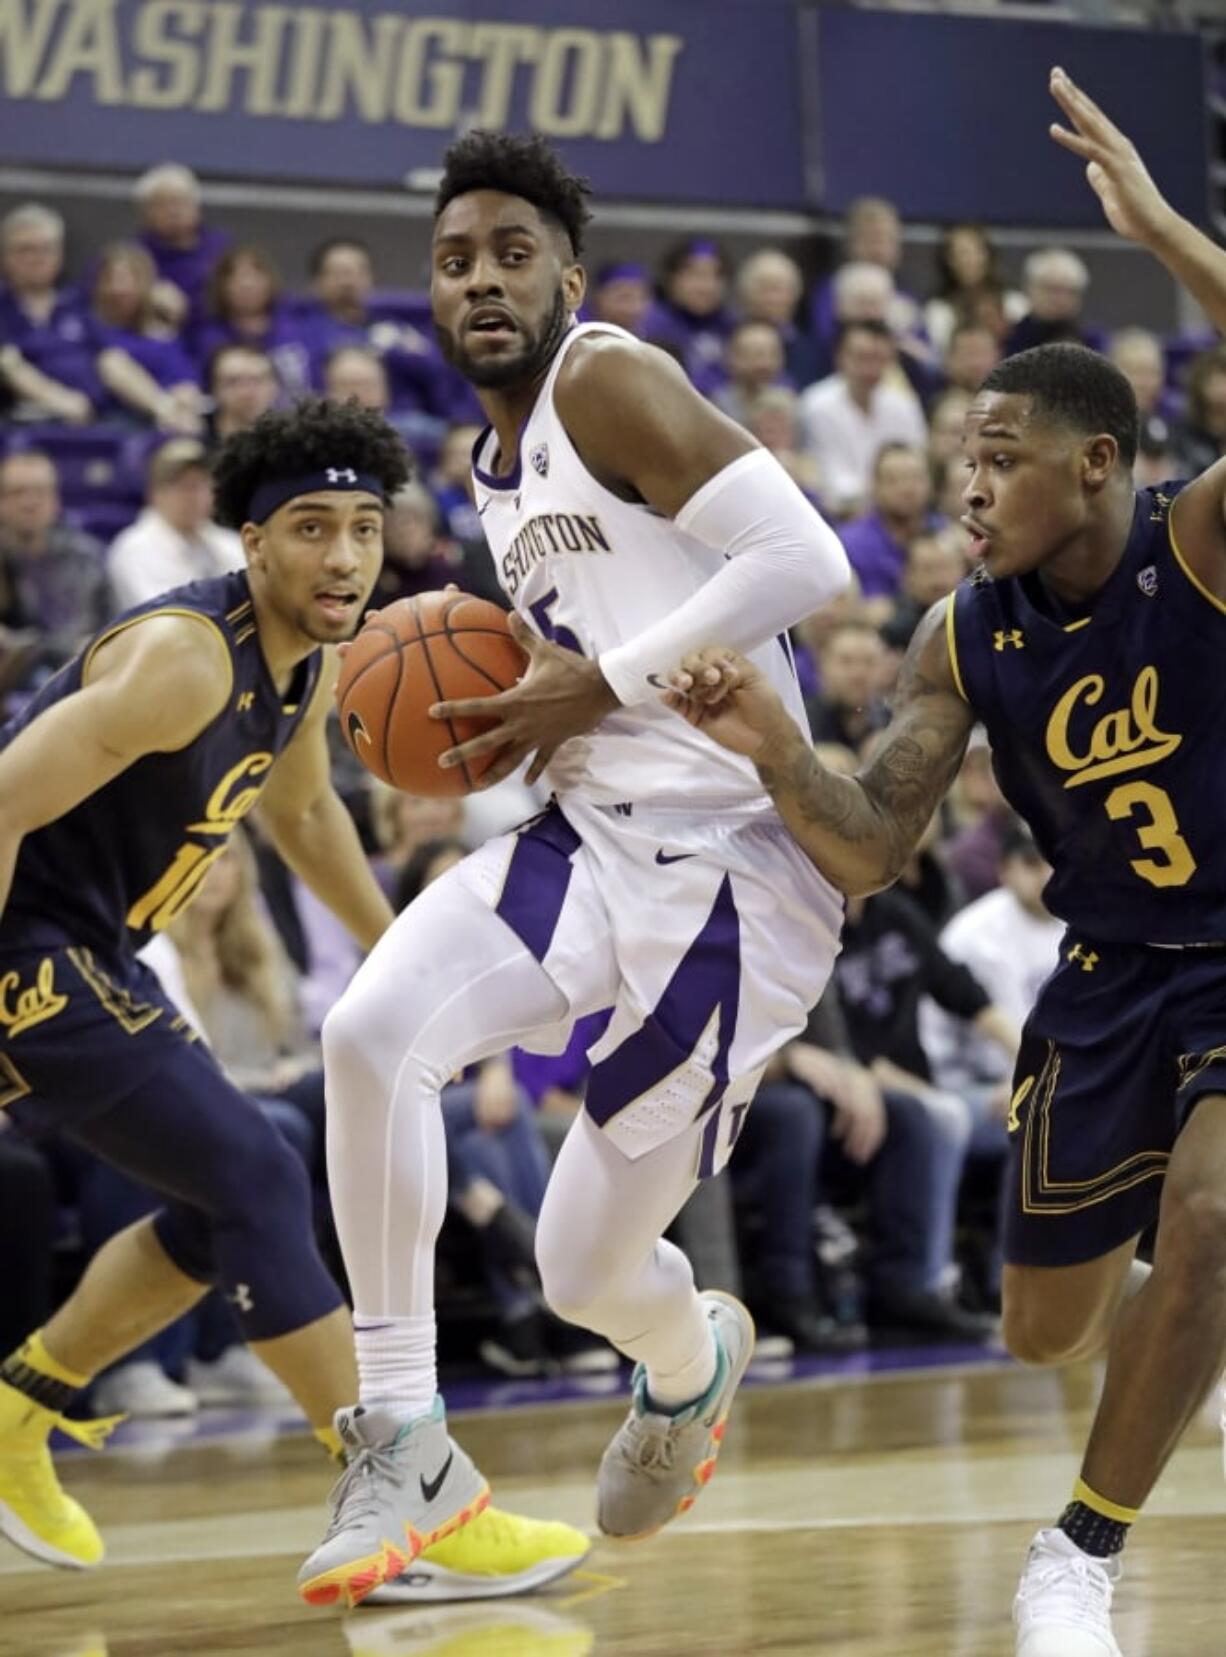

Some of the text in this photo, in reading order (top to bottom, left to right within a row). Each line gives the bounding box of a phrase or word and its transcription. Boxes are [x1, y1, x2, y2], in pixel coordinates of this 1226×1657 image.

[1046, 665, 1183, 789] Cal
[186, 752, 274, 834] Ca
[1104, 781, 1197, 888] 3
[0, 957, 68, 1039] Cal
